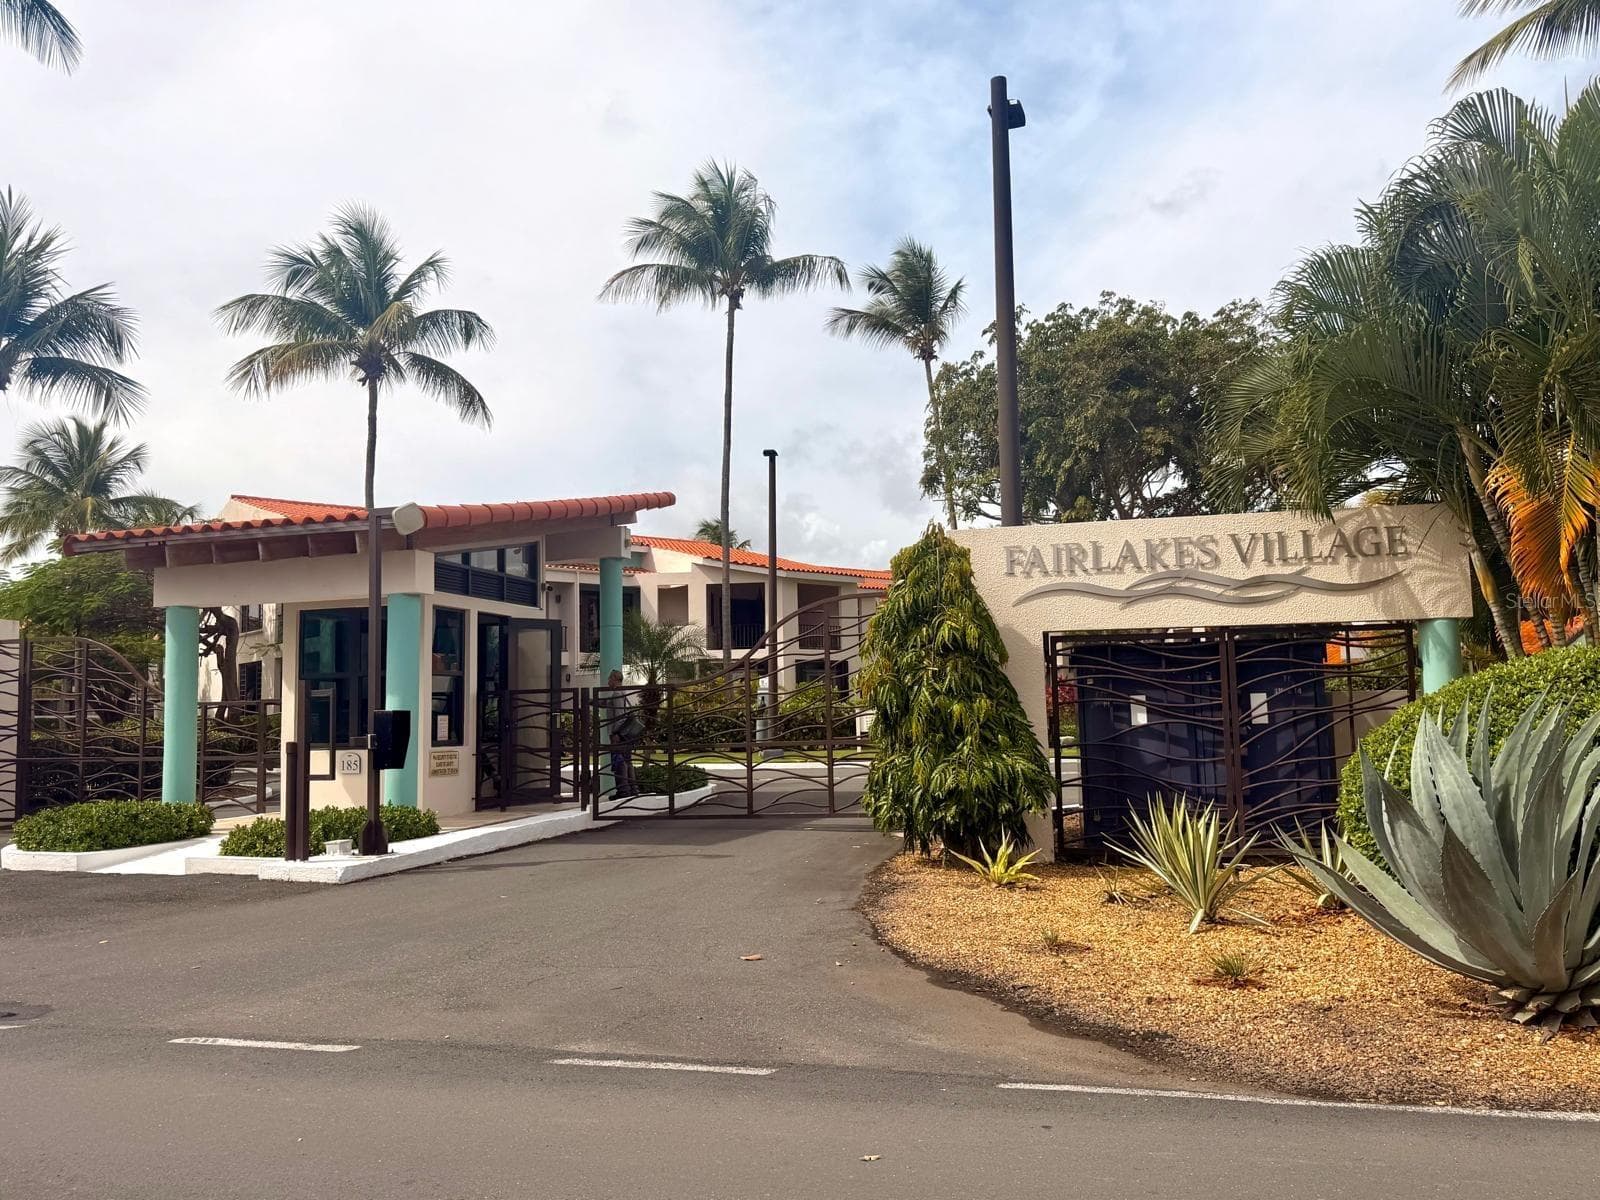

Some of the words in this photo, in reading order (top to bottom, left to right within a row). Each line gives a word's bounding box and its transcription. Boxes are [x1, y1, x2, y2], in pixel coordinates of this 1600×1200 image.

[1003, 536, 1220, 577] FAIRLAKES
[1227, 525, 1409, 565] VILLAGE
[341, 760, 359, 771] 185
